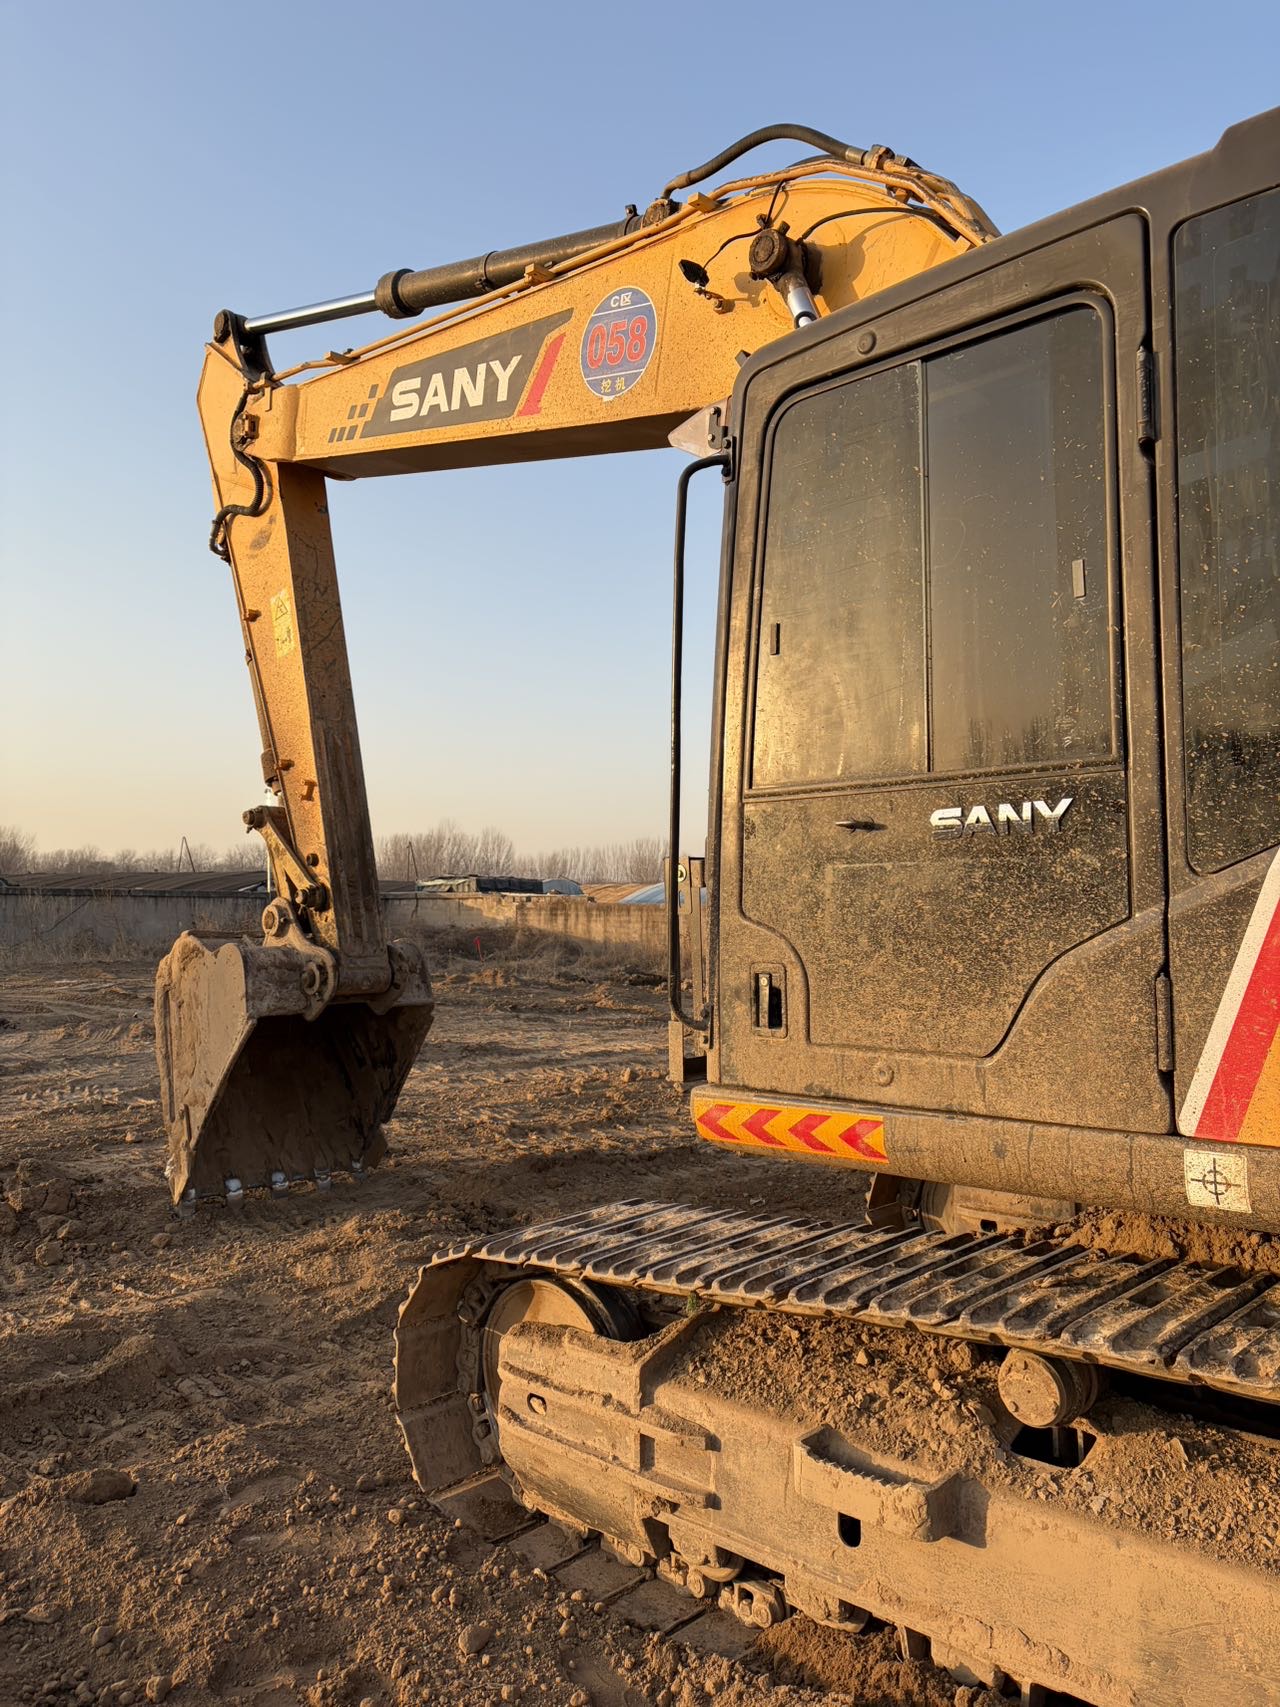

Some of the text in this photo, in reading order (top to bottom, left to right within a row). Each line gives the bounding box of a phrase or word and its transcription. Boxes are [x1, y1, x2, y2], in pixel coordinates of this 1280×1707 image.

[610, 291, 632, 308] C区
[586, 315, 648, 369] 058
[390, 354, 522, 422] SANY
[929, 797, 1074, 840] SANY
